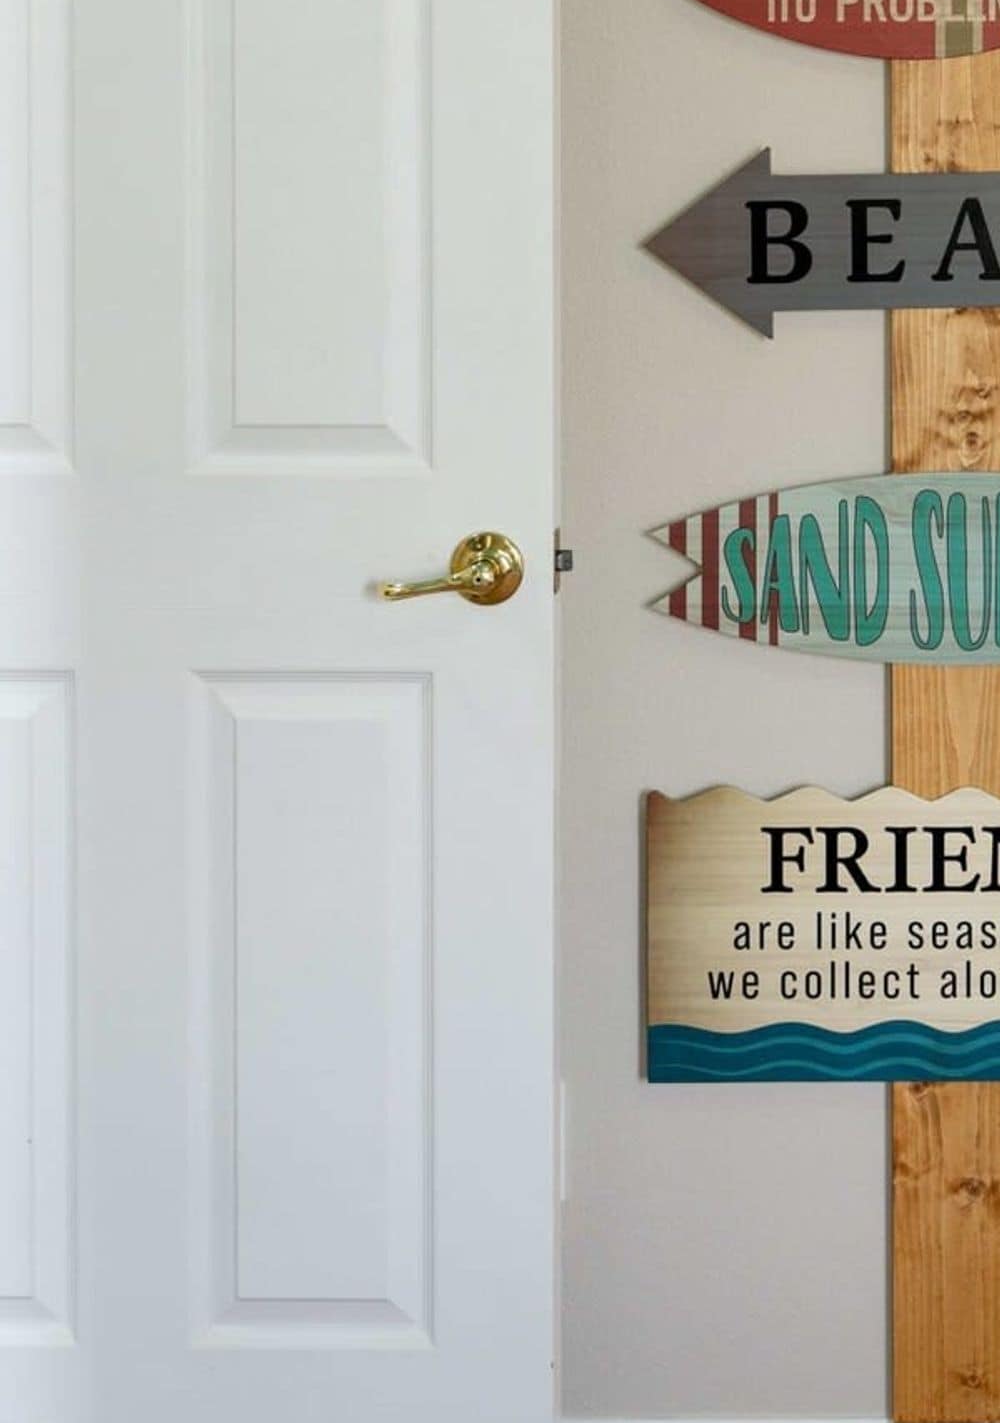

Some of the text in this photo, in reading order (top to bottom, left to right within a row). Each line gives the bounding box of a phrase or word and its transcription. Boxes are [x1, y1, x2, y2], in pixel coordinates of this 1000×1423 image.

[721, 495, 889, 647] SAND
[733, 920, 796, 950] are
[815, 912, 888, 950] like
[708, 969, 760, 1000] we
[780, 961, 920, 1000] collect
